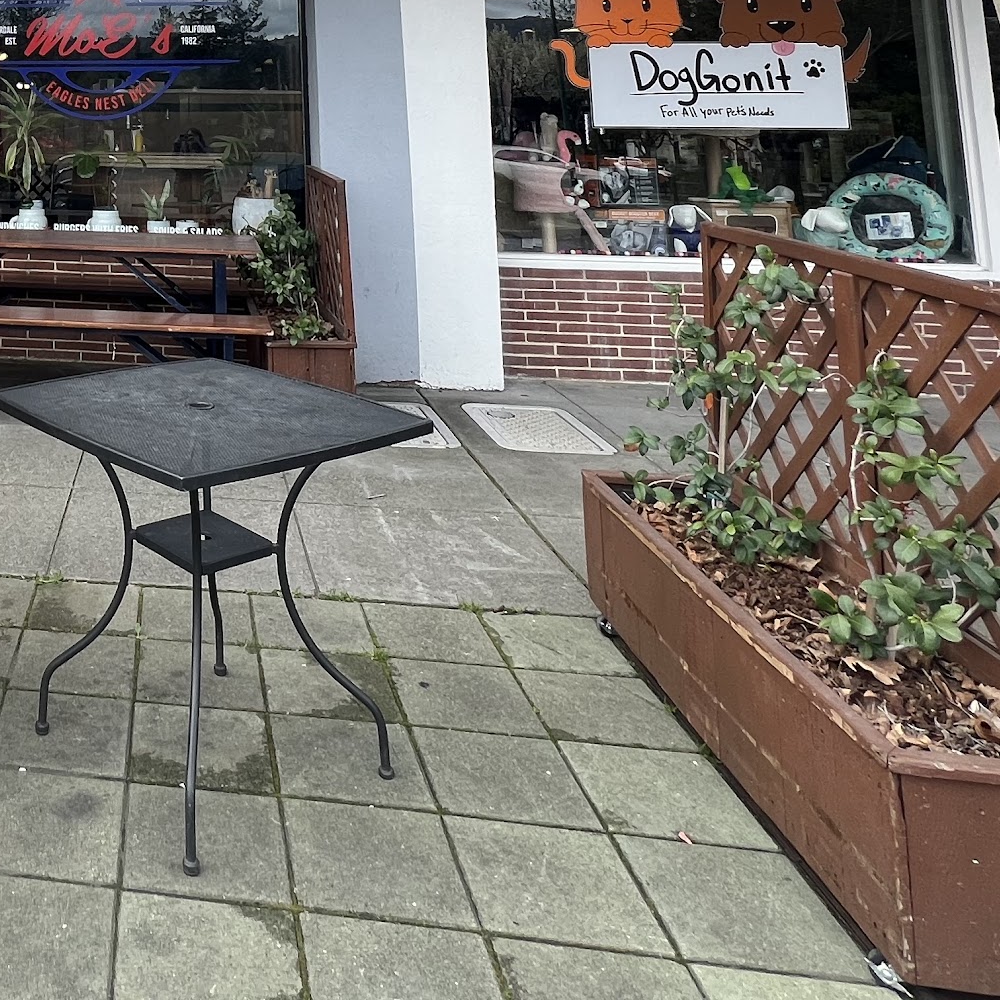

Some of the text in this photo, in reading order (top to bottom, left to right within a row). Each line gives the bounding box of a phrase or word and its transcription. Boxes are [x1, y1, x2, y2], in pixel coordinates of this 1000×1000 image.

[180, 24, 216, 34] CALIFORNIA
[45, 77, 157, 111] EAGLES NEST DELI
[660, 104, 679, 118] For
[681, 106, 698, 118] All
[700, 107, 724, 119] your
